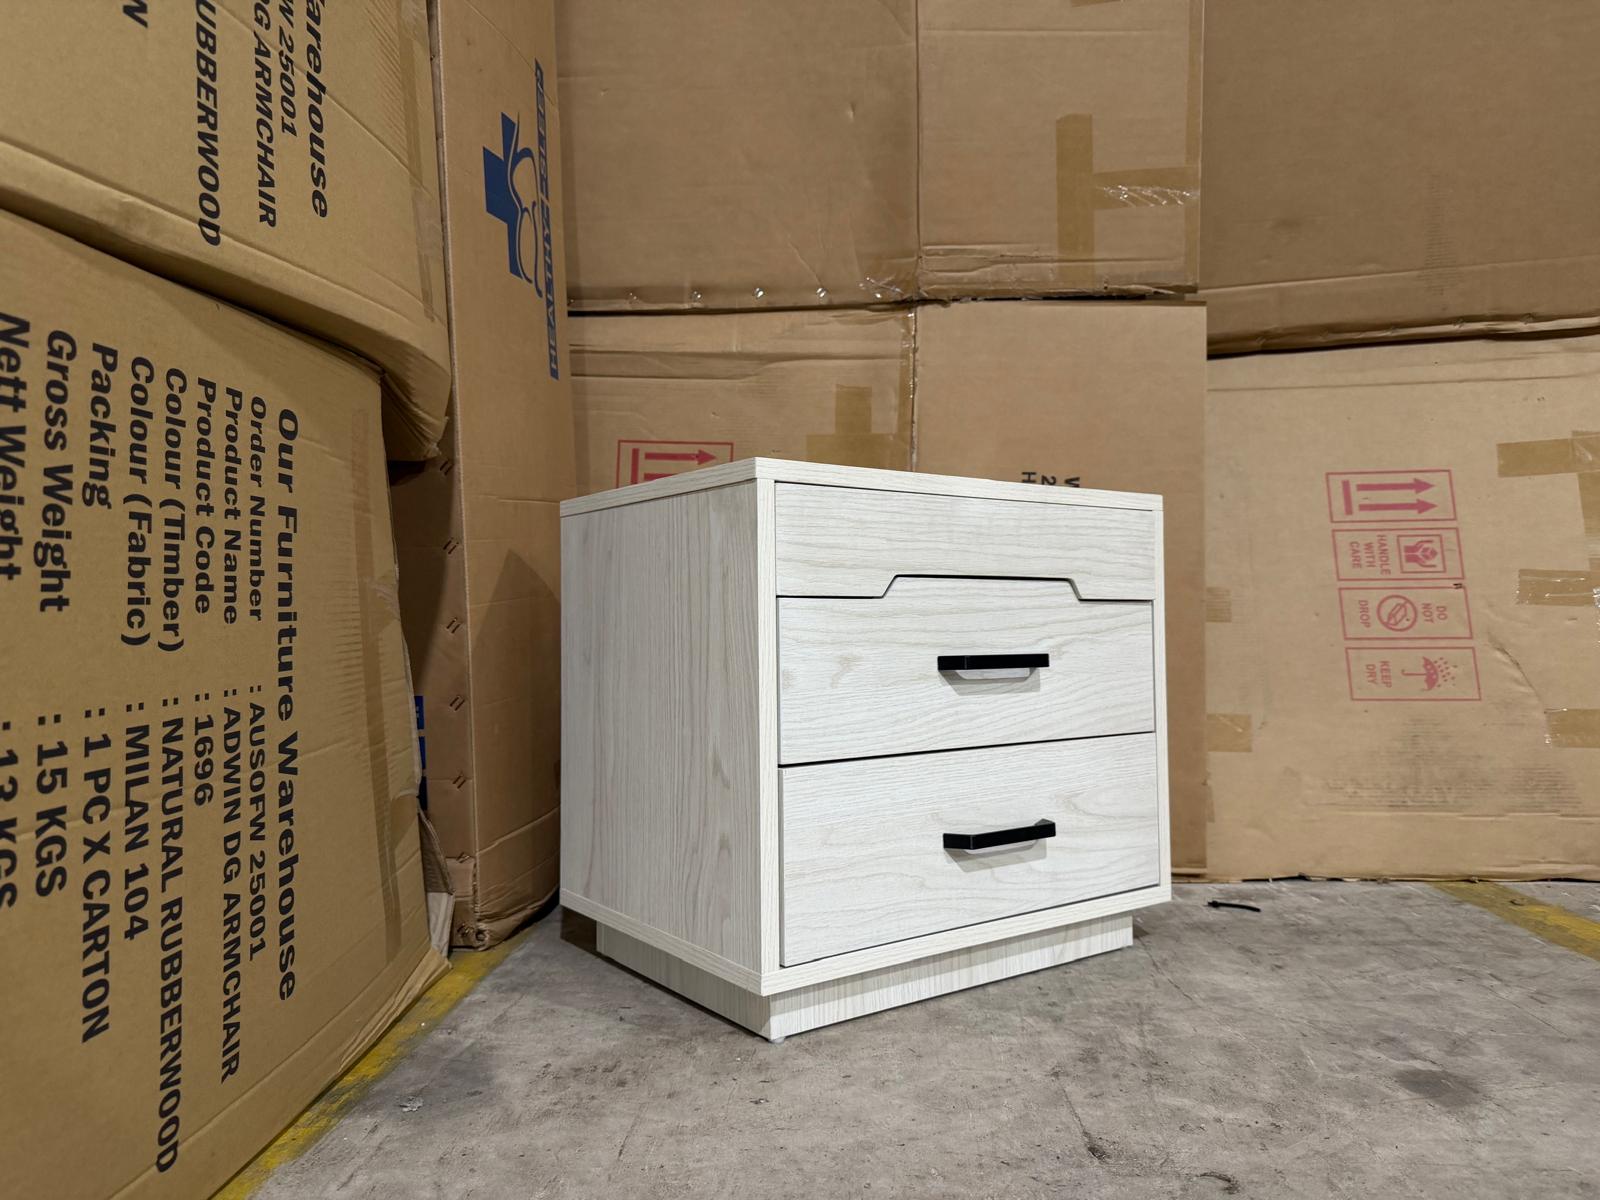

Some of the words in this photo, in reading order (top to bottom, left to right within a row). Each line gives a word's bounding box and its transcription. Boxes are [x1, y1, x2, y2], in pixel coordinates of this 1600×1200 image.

[254, 0, 270, 30] G
[254, 30, 276, 227] ARMCHAIR
[279, 26, 297, 136] 25001
[306, 0, 327, 217] arehouse
[0, 312, 30, 412] Nett
[44, 330, 77, 450] Gross
[82, 343, 118, 509] Packing
[129, 357, 154, 484] Colour
[165, 368, 187, 489] Colour
[196, 377, 216, 516] Product
[225, 387, 242, 520] Product
[250, 397, 266, 488] Order
[278, 409, 298, 493] Our
[33, 464, 73, 612] Weight
[121, 494, 152, 645] (Fabric)
[158, 499, 185, 651] (Timber)
[195, 526, 215, 613] Code
[224, 529, 241, 624] Name
[250, 496, 265, 621] Number
[1350, 541, 1362, 568] CARE
[1363, 542, 1376, 568] WITH
[1377, 534, 1391, 575] HANDLE
[278, 506, 297, 721] Furniture
[1358, 600, 1370, 628] DROP
[1422, 603, 1434, 624] NOT
[1436, 605, 1448, 620] DO
[1365, 663, 1378, 685] DRY
[1380, 660, 1392, 688] KEEP
[36, 741, 68, 794] 15
[82, 768, 111, 824] PC
[84, 734, 111, 758] 1
[125, 725, 149, 852] MILAN
[194, 715, 214, 806] 1696
[223, 707, 241, 824] ADWIN
[250, 703, 265, 840] AUSOFW
[35, 805, 67, 897] KGS
[83, 831, 110, 864] X
[161, 718, 183, 893] NATURAL
[223, 831, 241, 884] DG
[124, 863, 149, 940] 104
[250, 850, 265, 961] 25001
[278, 731, 298, 1000] Warehouse
[82, 870, 110, 1043] CARTON
[221, 894, 240, 1083] ARMCHAIR
[155, 897, 182, 1172] RUBBERWOOD
